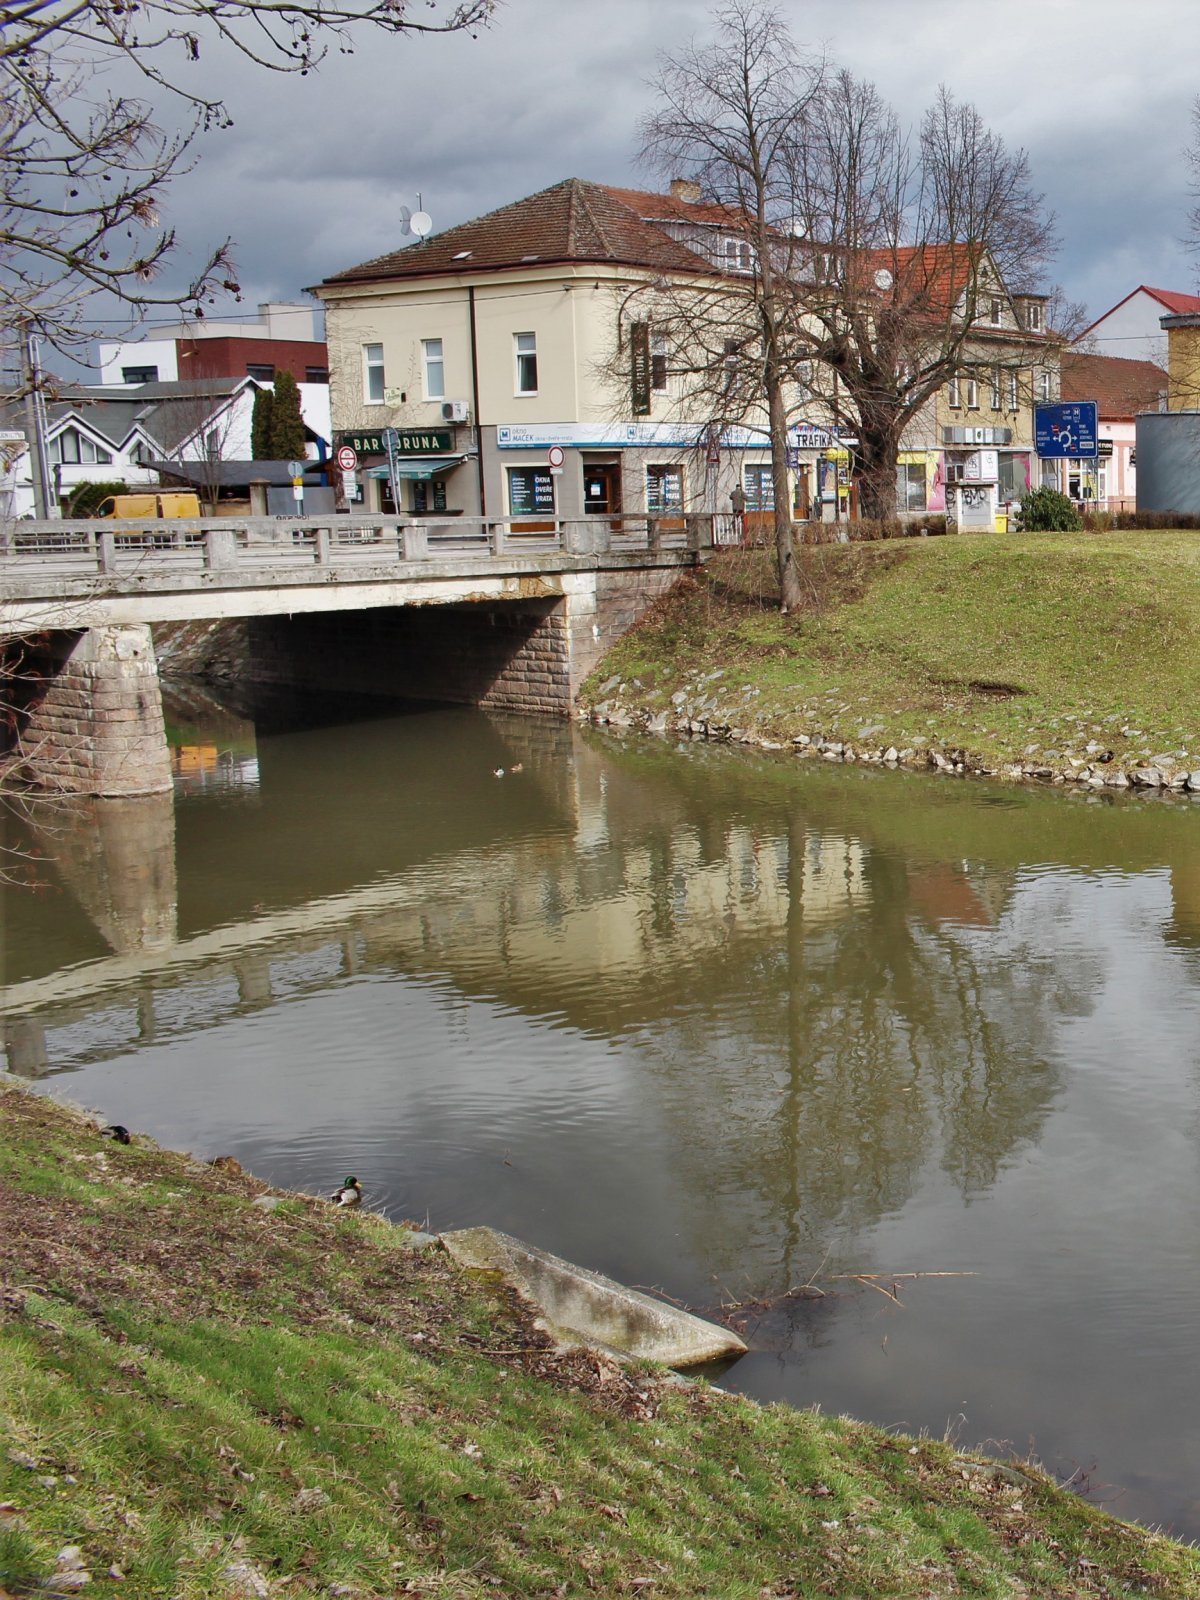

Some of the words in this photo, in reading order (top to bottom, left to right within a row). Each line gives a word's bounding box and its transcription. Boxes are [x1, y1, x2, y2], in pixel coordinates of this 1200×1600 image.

[353, 439, 380, 451] BAR
[396, 436, 440, 449] ORUNA
[796, 433, 833, 447] TRAFIKA
[535, 485, 553, 493] DVEŘE
